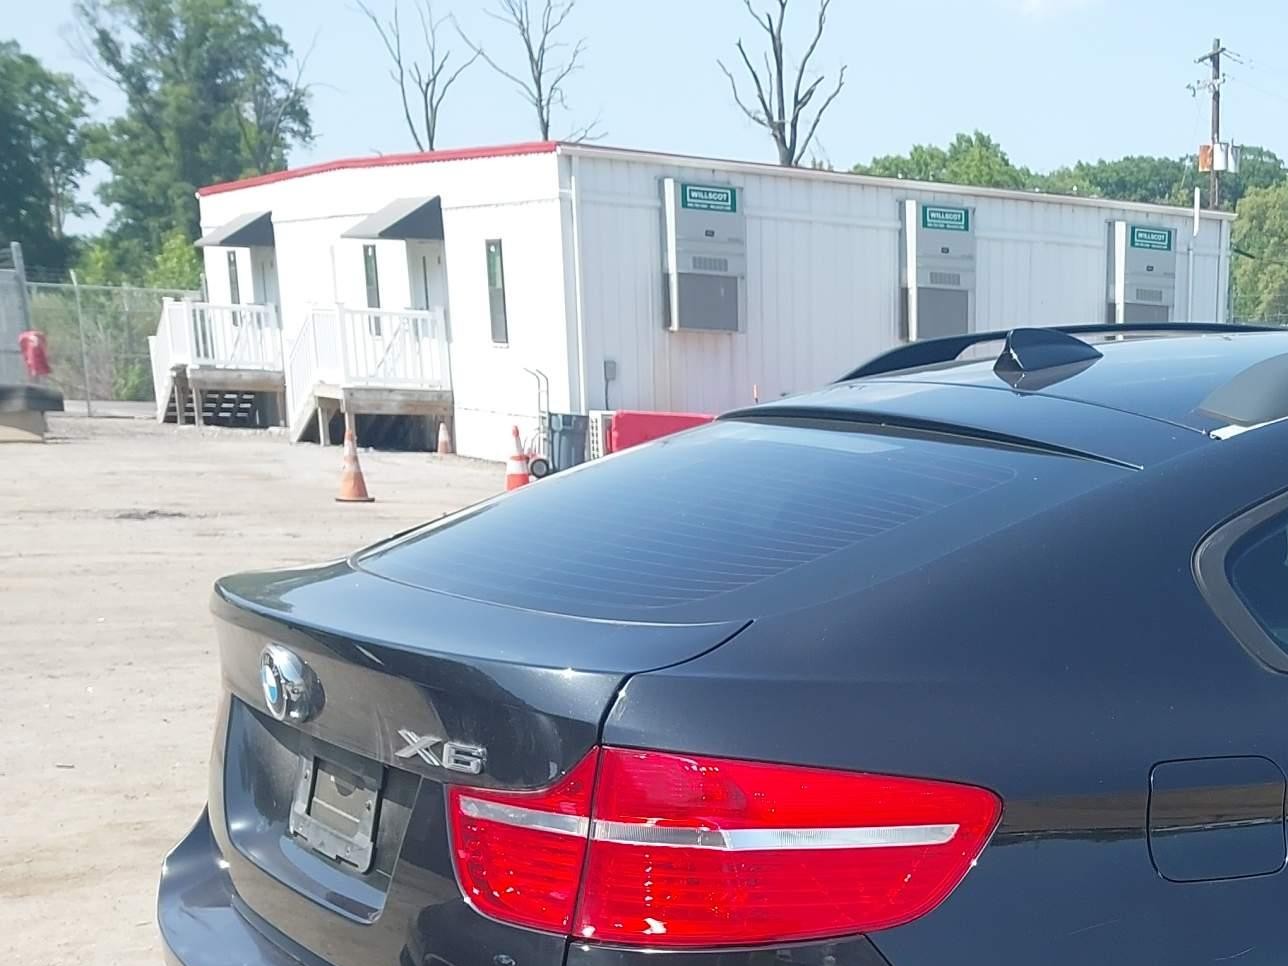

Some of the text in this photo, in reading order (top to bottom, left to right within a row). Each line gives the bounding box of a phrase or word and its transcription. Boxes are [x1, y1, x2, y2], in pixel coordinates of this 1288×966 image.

[690, 190, 728, 201] WILLSCOT
[930, 212, 961, 221] WILLSCOT
[394, 728, 487, 775] X6
